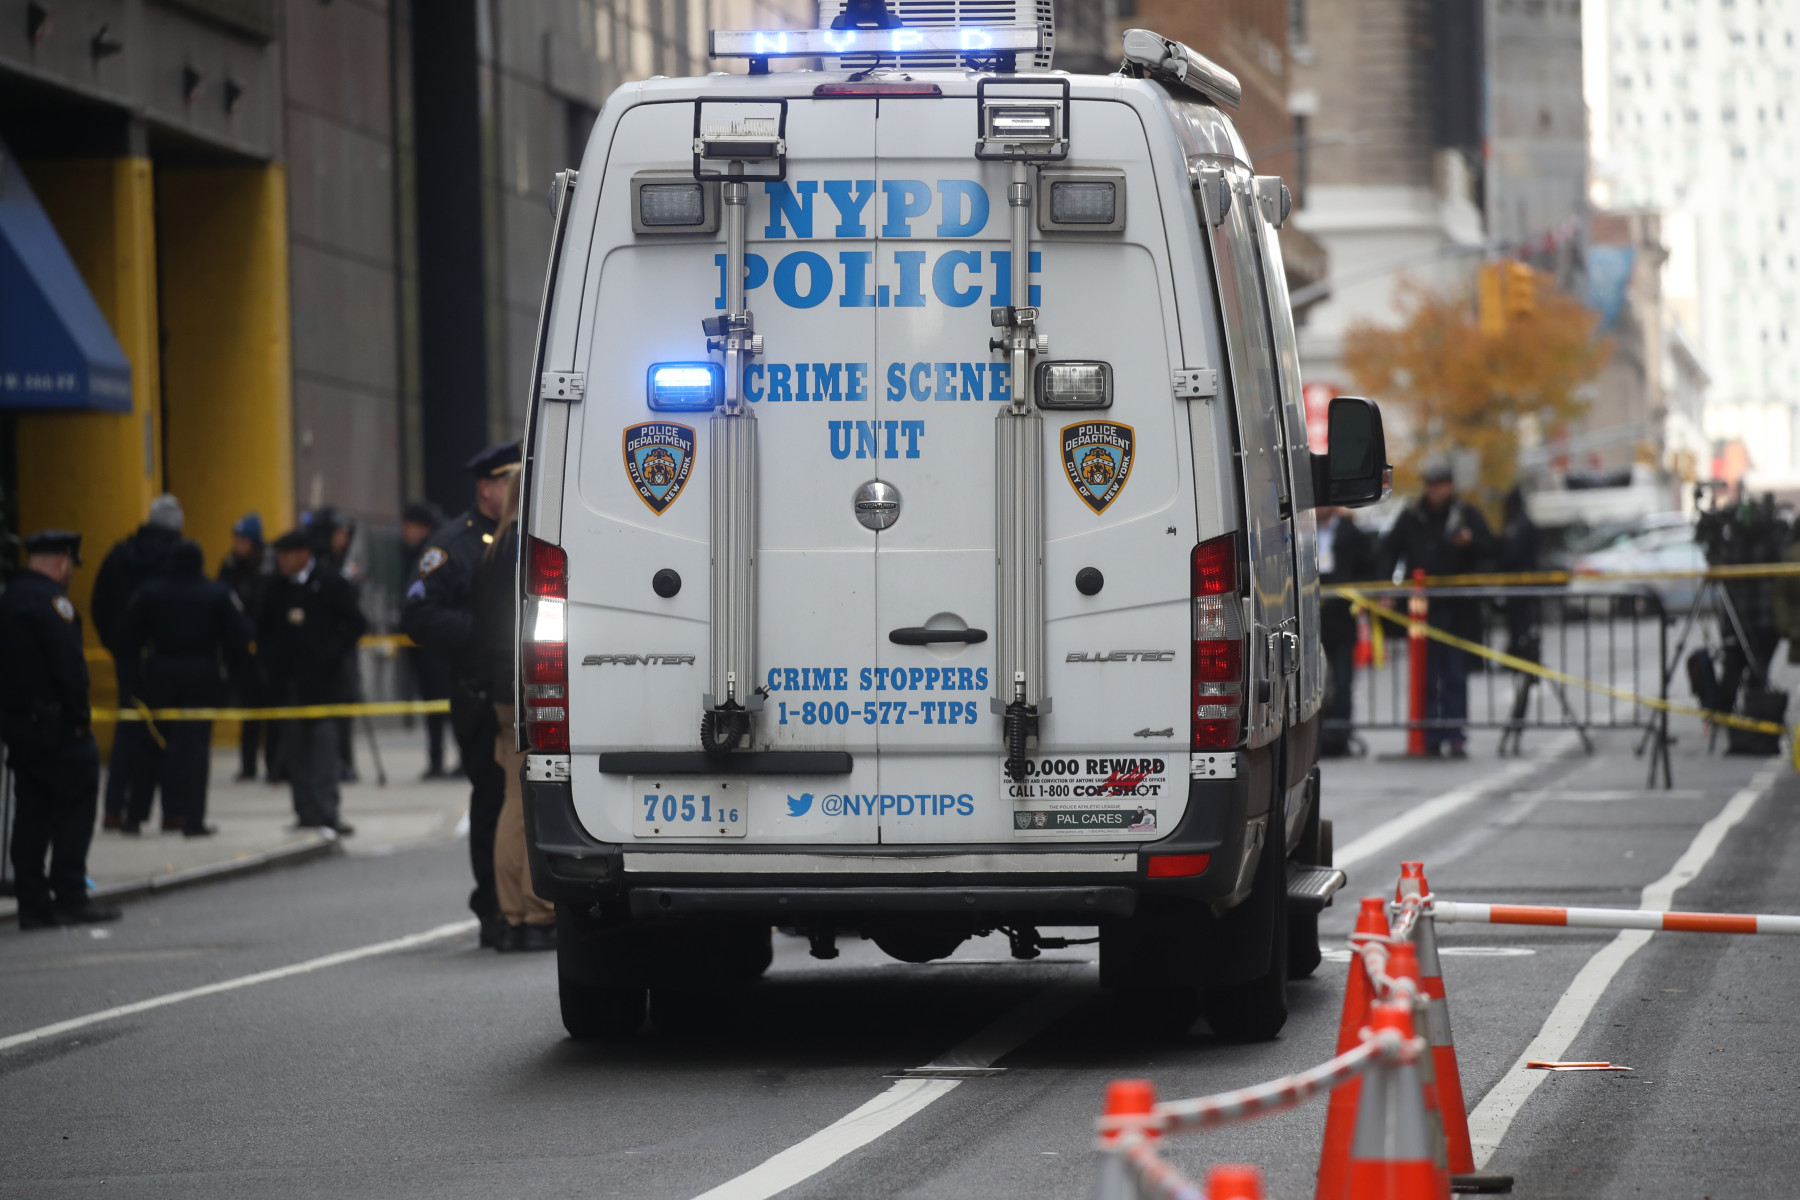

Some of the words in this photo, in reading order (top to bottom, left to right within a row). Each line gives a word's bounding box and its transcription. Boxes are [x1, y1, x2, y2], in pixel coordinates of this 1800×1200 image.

[765, 180, 990, 239] NYPD
[714, 250, 1042, 310] POLICE
[743, 362, 868, 403] CRIME
[887, 362, 1011, 402] SCENE
[642, 426, 678, 436] POLICE
[828, 420, 925, 460] UNIT
[1079, 425, 1116, 436] POLICE
[628, 435, 691, 452] DEPARTMENT
[1066, 434, 1130, 452] DEPARTMENT
[628, 462, 642, 483] CITY
[640, 486, 651, 498] OF
[664, 483, 680, 502] NEW
[678, 456, 692, 480] YORK
[1067, 462, 1080, 483] CITY
[1079, 486, 1090, 497] OF
[1104, 482, 1120, 502] NEW
[1118, 456, 1130, 480] YORK
[582, 654, 695, 666] SPRINTER
[1066, 650, 1175, 662] BLUETEC
[768, 668, 848, 691] CRIME
[860, 667, 988, 691] STOPPERS
[778, 702, 978, 725] 1-800-577-TIPS
[1133, 727, 1174, 738] 4x4
[1004, 758, 1080, 778] $0,000
[1086, 758, 1164, 775] REWARD
[1008, 784, 1035, 798] CALL
[1039, 784, 1070, 797] 1-800
[1073, 784, 1160, 797] COP-SHOT
[644, 795, 712, 822] 7051
[718, 808, 738, 822] 16
[822, 794, 974, 816] @NYPDTIPS
[1057, 814, 1078, 824] PAL
[1082, 814, 1122, 824] CARES
